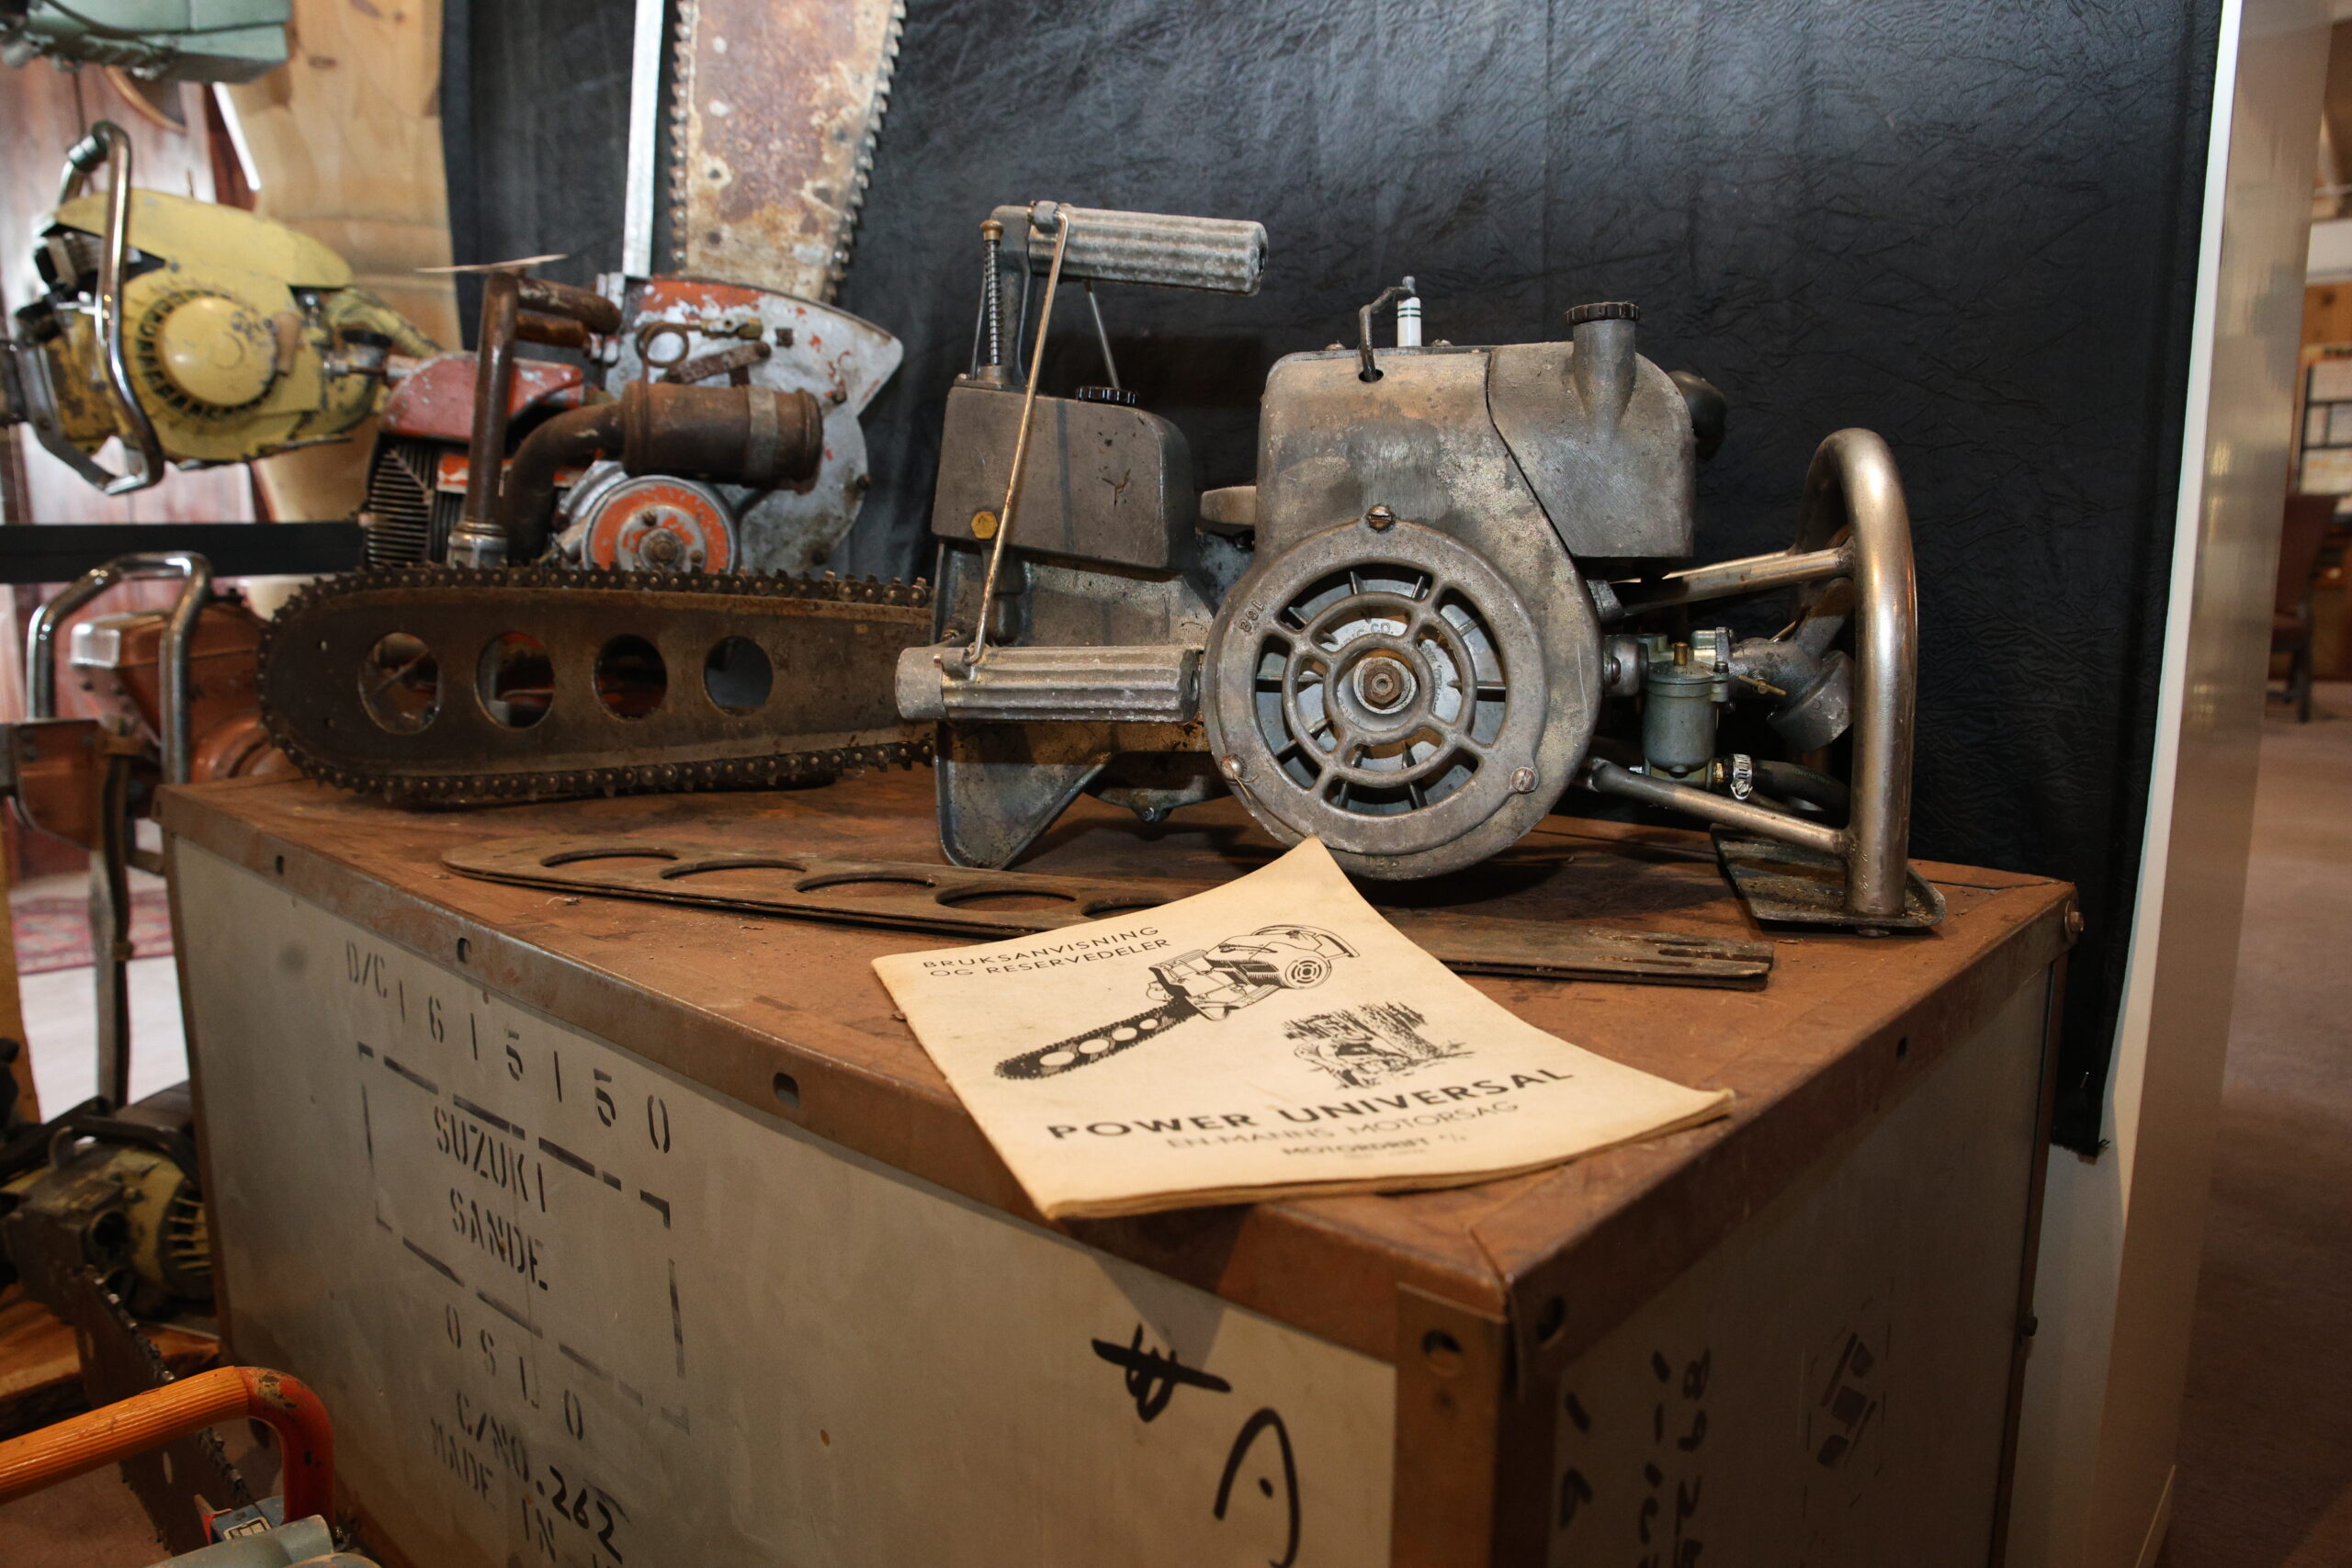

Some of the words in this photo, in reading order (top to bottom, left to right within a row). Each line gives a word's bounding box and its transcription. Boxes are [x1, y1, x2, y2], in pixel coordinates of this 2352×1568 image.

[922, 927, 1159, 968] BRUKSANVISNING
[930, 968, 974, 976] OG
[987, 939, 1171, 974] RESERVEDELER
[1046, 1113, 1259, 1140] POWER
[1278, 1066, 1574, 1122] UNIVERSAL
[435, 1106, 546, 1213] SUZUKI
